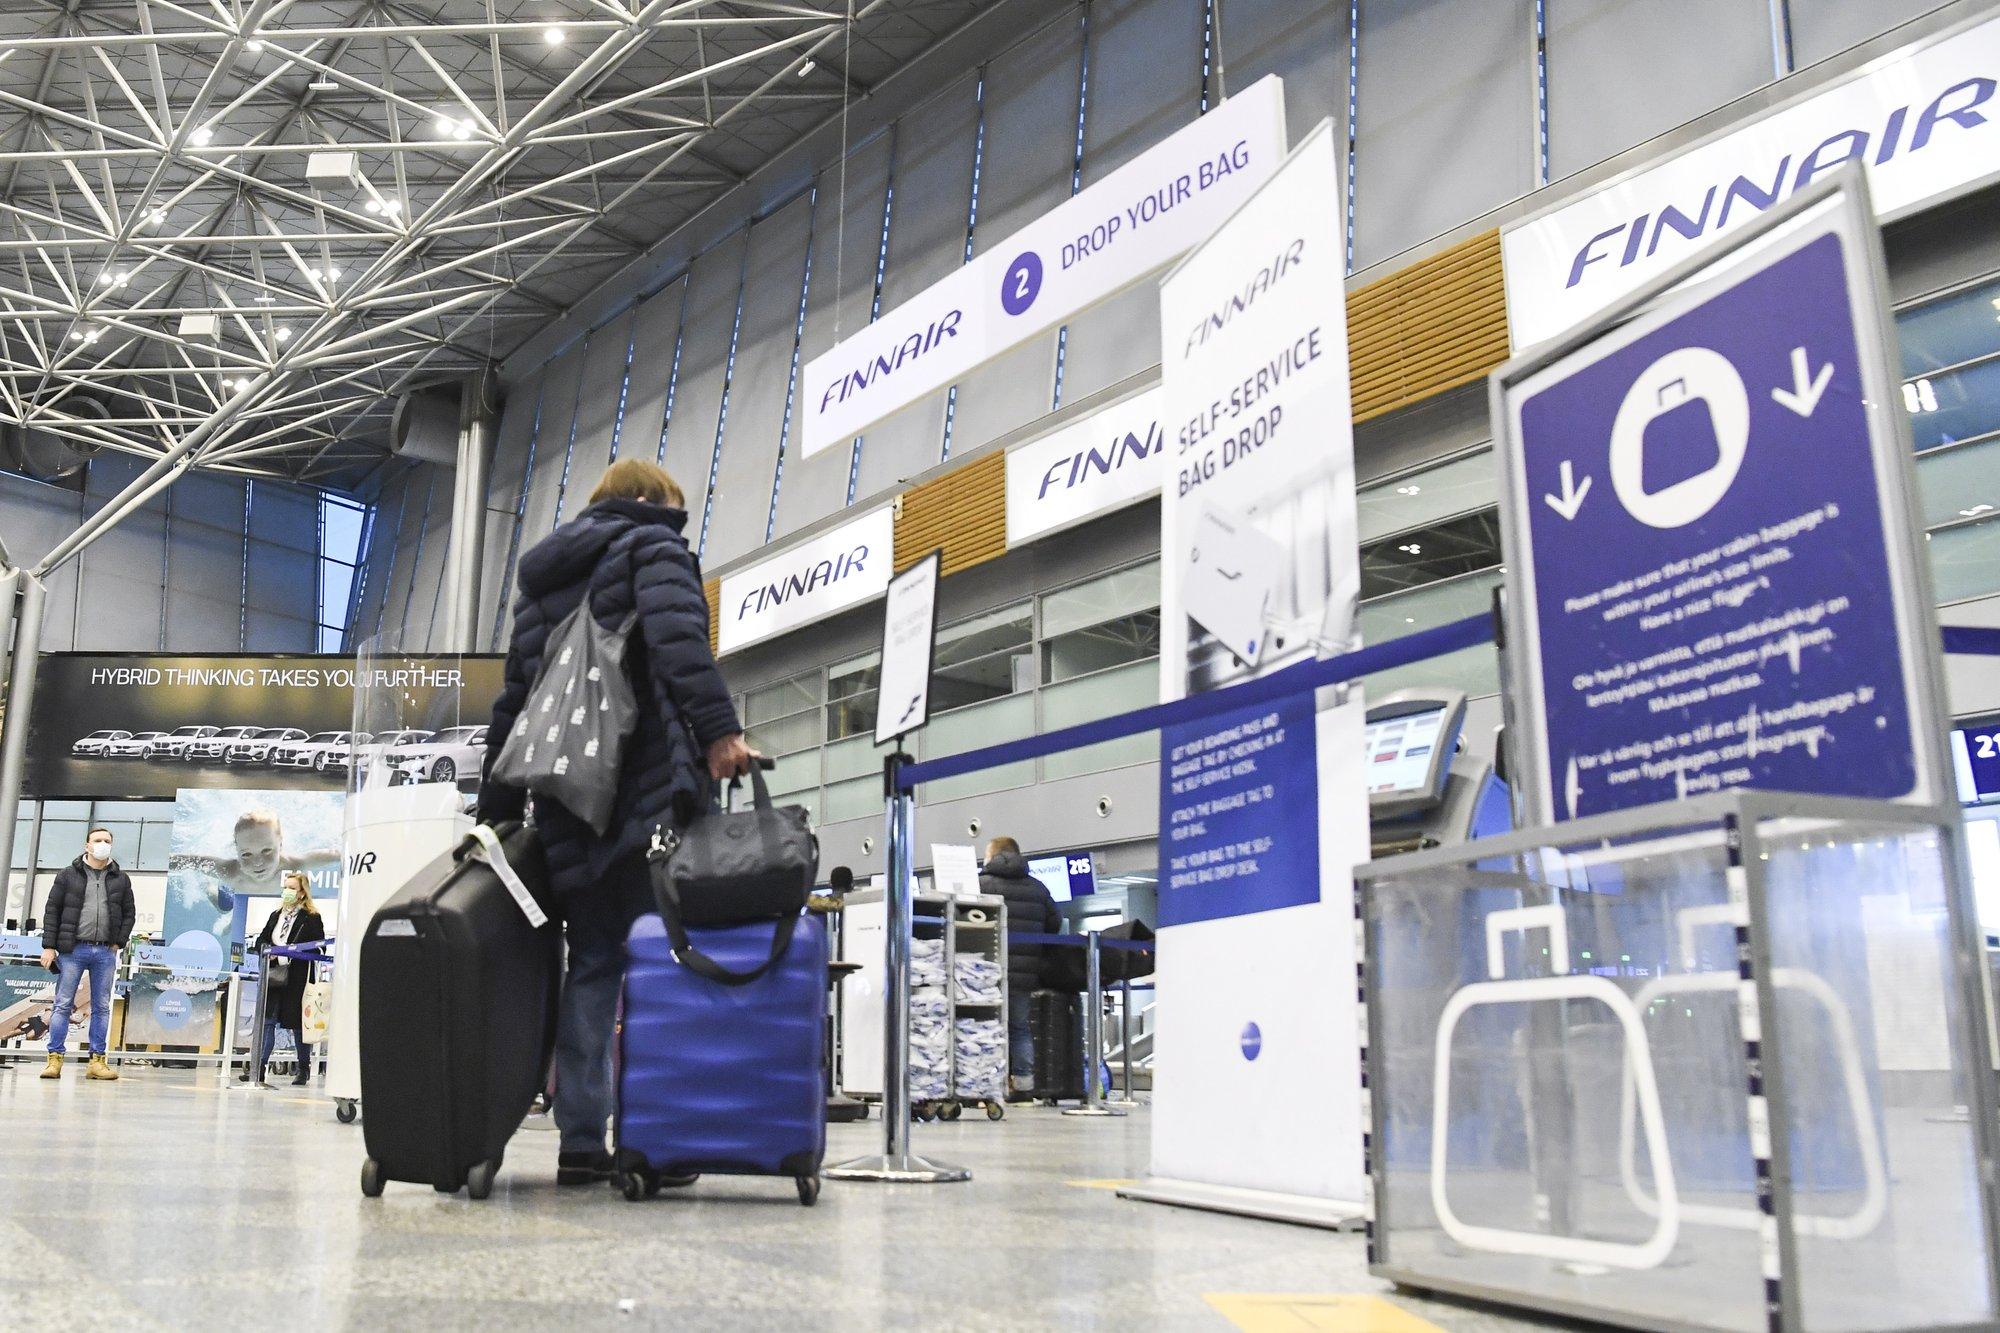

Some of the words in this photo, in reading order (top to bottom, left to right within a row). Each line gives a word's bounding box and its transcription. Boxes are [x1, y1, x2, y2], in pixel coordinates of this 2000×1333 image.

[1015, 267, 1031, 300] 2
[1062, 216, 1121, 271] DROP
[1127, 175, 1191, 230] YOUR
[1198, 140, 1249, 191] BAG
[1565, 77, 1998, 289] FINNAIR
[1184, 238, 1305, 360] FINNAIR
[819, 309, 962, 414] FINNAIR
[1178, 326, 1321, 456] SELF-SERVICE
[1178, 450, 1214, 499] BAG
[1223, 404, 1283, 469] DROP
[738, 545, 869, 621] FINNAIR
[91, 668, 161, 685] HYBRID
[165, 668, 255, 687] THINKING
[258, 669, 320, 687] TAKES
[322, 669, 372, 688] YOU
[374, 669, 466, 688] FURTHER.
[1068, 857, 1091, 875] 215
